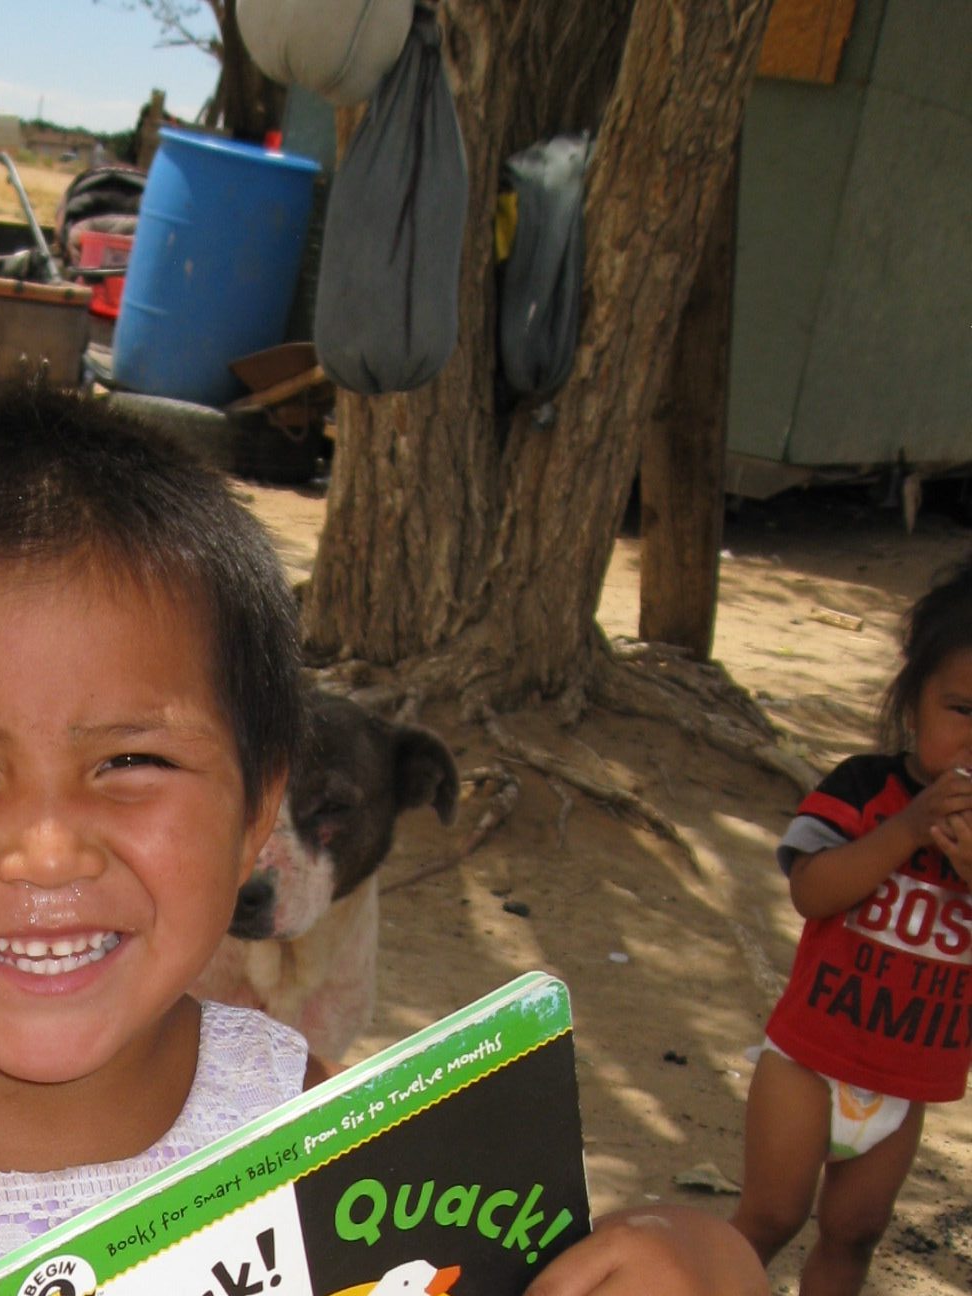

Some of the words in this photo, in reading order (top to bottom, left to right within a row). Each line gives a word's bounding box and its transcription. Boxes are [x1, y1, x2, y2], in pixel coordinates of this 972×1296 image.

[857, 878, 972, 955] BOS
[855, 942, 896, 979] OF
[911, 961, 969, 998] THE
[106, 1221, 156, 1257] Books
[161, 1205, 188, 1232] for
[193, 1175, 241, 1210] Smart
[247, 1143, 298, 1181] Babies
[303, 1126, 337, 1155] from
[341, 1111, 365, 1131] Six
[368, 1099, 384, 1120] to
[388, 1067, 443, 1105] Twelve
[334, 1178, 574, 1264] Quack!
